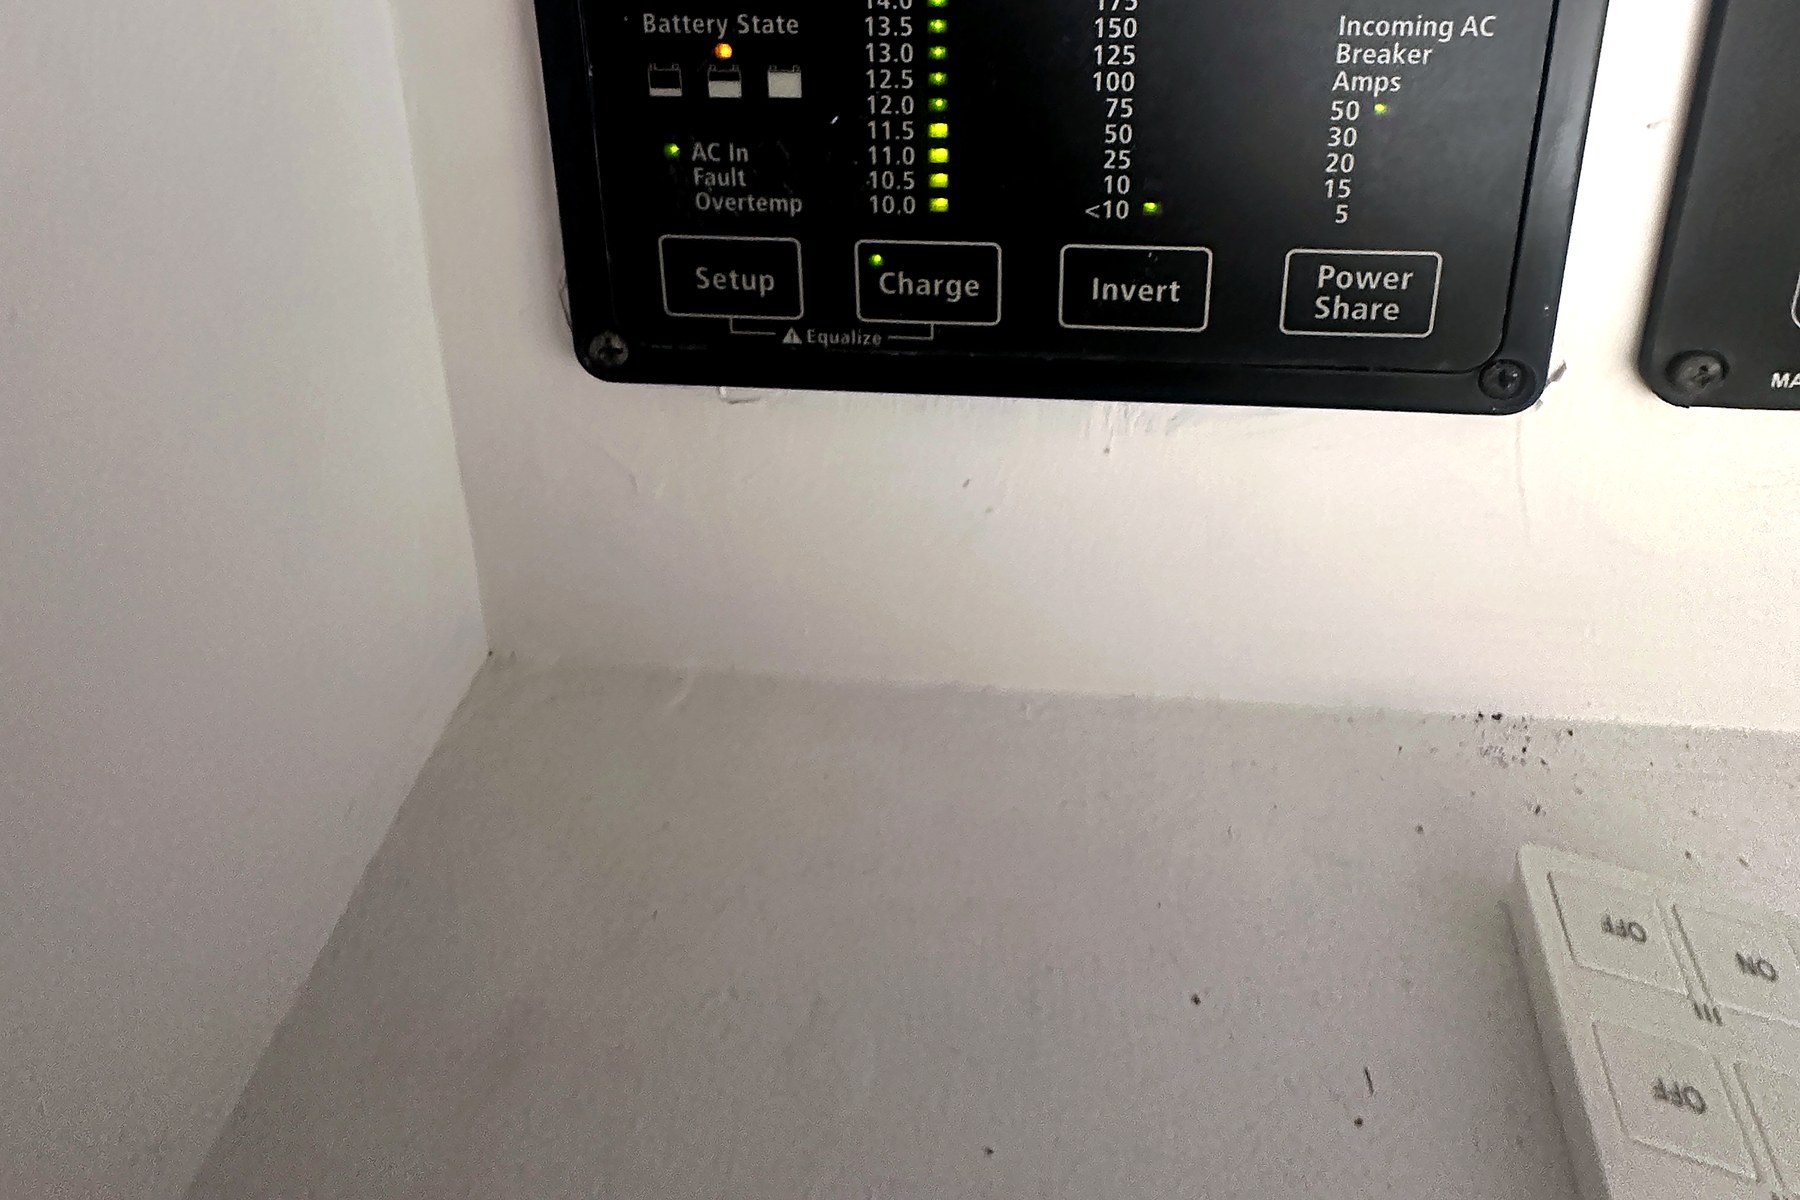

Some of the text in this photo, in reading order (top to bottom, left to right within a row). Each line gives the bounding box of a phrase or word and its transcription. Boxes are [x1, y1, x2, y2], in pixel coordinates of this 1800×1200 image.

[643, 13, 798, 39] Battery State
[865, 16, 912, 36] 13.5
[1095, 17, 1137, 38] 150
[1340, 15, 1496, 40] Incoming AC
[866, 43, 913, 62] 13.0
[1094, 45, 1135, 65] 125
[1336, 42, 1433, 64] Breaker
[866, 69, 913, 89] 12.5
[1094, 72, 1134, 91] 100
[1332, 71, 1401, 97] Amps
[868, 95, 914, 115] 12.0
[1106, 98, 1133, 117] 75
[1331, 101, 1359, 120] 50
[868, 121, 914, 140] 11.5
[1105, 124, 1132, 144] 50
[1328, 127, 1357, 147] 30
[692, 142, 748, 162] AC In
[869, 146, 915, 165] 11.0
[1104, 150, 1130, 169] 25
[1326, 153, 1354, 173] 20
[694, 167, 746, 187] Fault
[869, 171, 914, 189] 10.5
[1105, 175, 1130, 194] 10
[1325, 179, 1350, 198] 15
[696, 192, 802, 217] Overtemp
[870, 195, 915, 214] 10.0
[1086, 200, 1129, 219] <10
[1336, 205, 1348, 223] 5
[696, 267, 774, 297] Setup
[880, 271, 979, 302] Charge
[1318, 265, 1413, 289] Power
[1093, 278, 1180, 302] Invert
[1315, 295, 1399, 320] Share
[807, 329, 881, 347] Equalize
